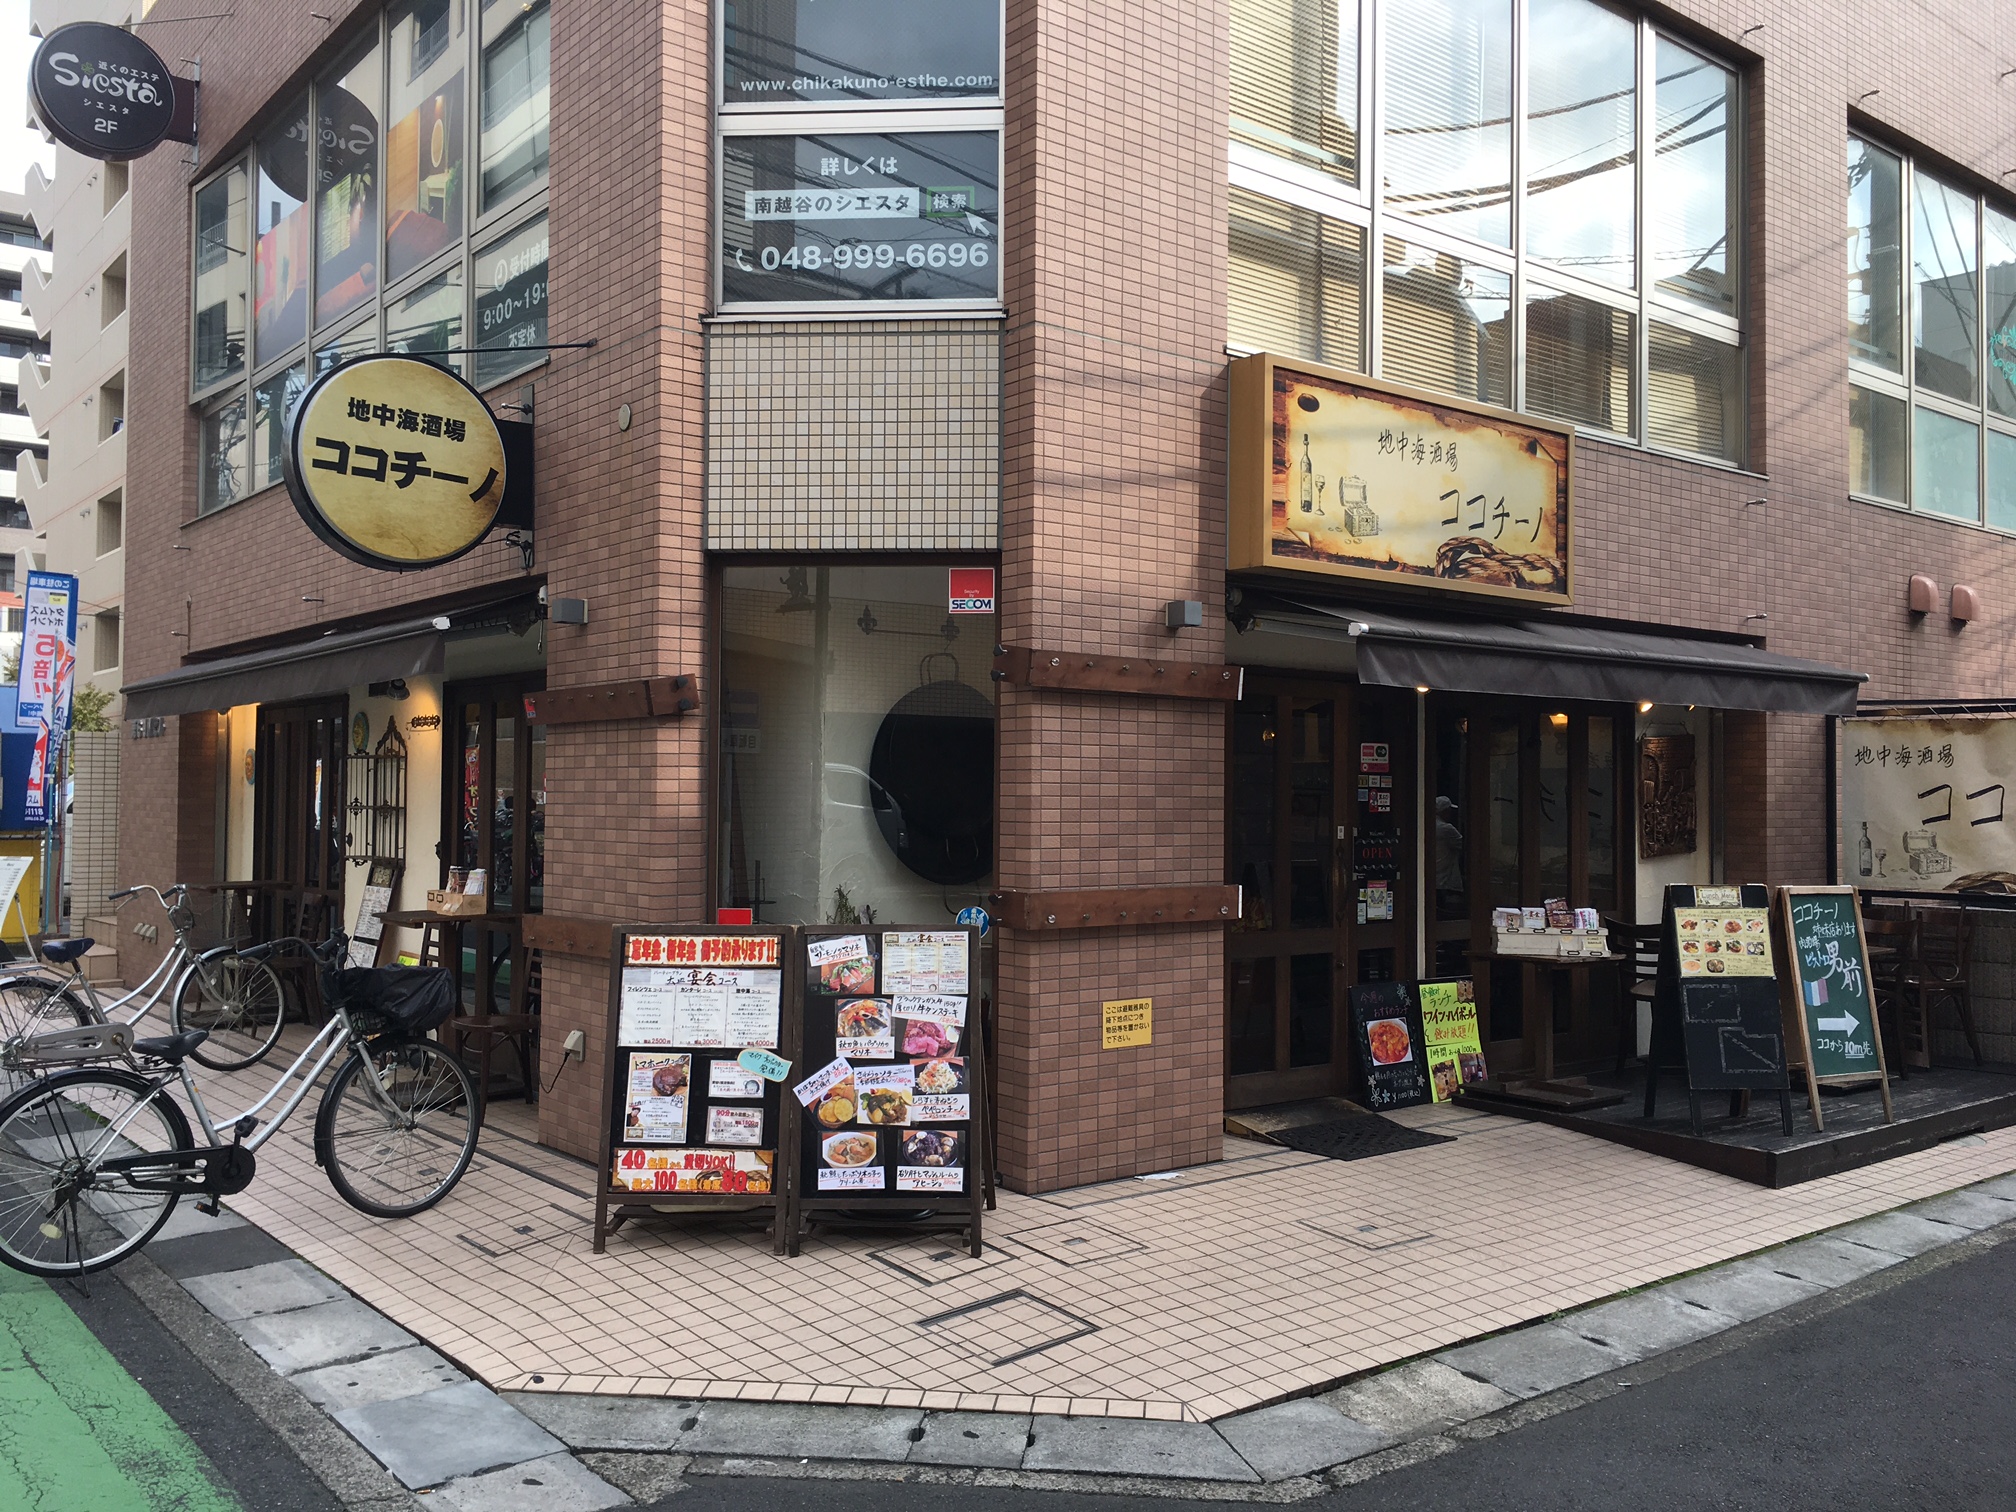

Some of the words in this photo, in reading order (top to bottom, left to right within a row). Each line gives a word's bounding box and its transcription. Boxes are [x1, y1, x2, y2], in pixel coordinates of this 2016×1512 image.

[49, 52, 162, 106] Siesta
[98, 60, 160, 82] 近くのエステ
[740, 73, 993, 92] www.chikakuno-esthe.com
[83, 98, 130, 115] シエスタ
[94, 117, 118, 134] 2F
[820, 156, 898, 177] 詳しくは
[754, 193, 910, 215] 南越谷のシエスタ
[932, 193, 968, 210] 検索
[761, 242, 990, 271] 048-999-6696
[347, 396, 467, 444] 地中海酒場
[1378, 428, 1459, 472] 地中海酒場
[312, 436, 500, 503] ココチーノ
[1439, 488, 1544, 543] ココチーノ
[951, 598, 992, 610] SECOM
[1854, 743, 1955, 769] 地中海酒場
[1918, 783, 2005, 828] ココ
[1362, 847, 1392, 859] OPEN
[1701, 892, 1720, 900] Lunch
[1721, 892, 1736, 900] Menu
[1793, 902, 1838, 925] ココチーノ
[1812, 920, 1856, 938] 姉妹店あります
[1805, 948, 1829, 969] ビストロ
[1821, 940, 1862, 998] 男前
[1106, 1003, 1150, 1015] ここは避難器具の
[1430, 989, 1452, 1008] ランチ
[1106, 1013, 1144, 1024] 降下地点につき
[1423, 1006, 1477, 1025] ワイン・ハイボール
[1106, 1022, 1150, 1034] 物品等を置かない
[1106, 1035, 1131, 1044] で下さい。
